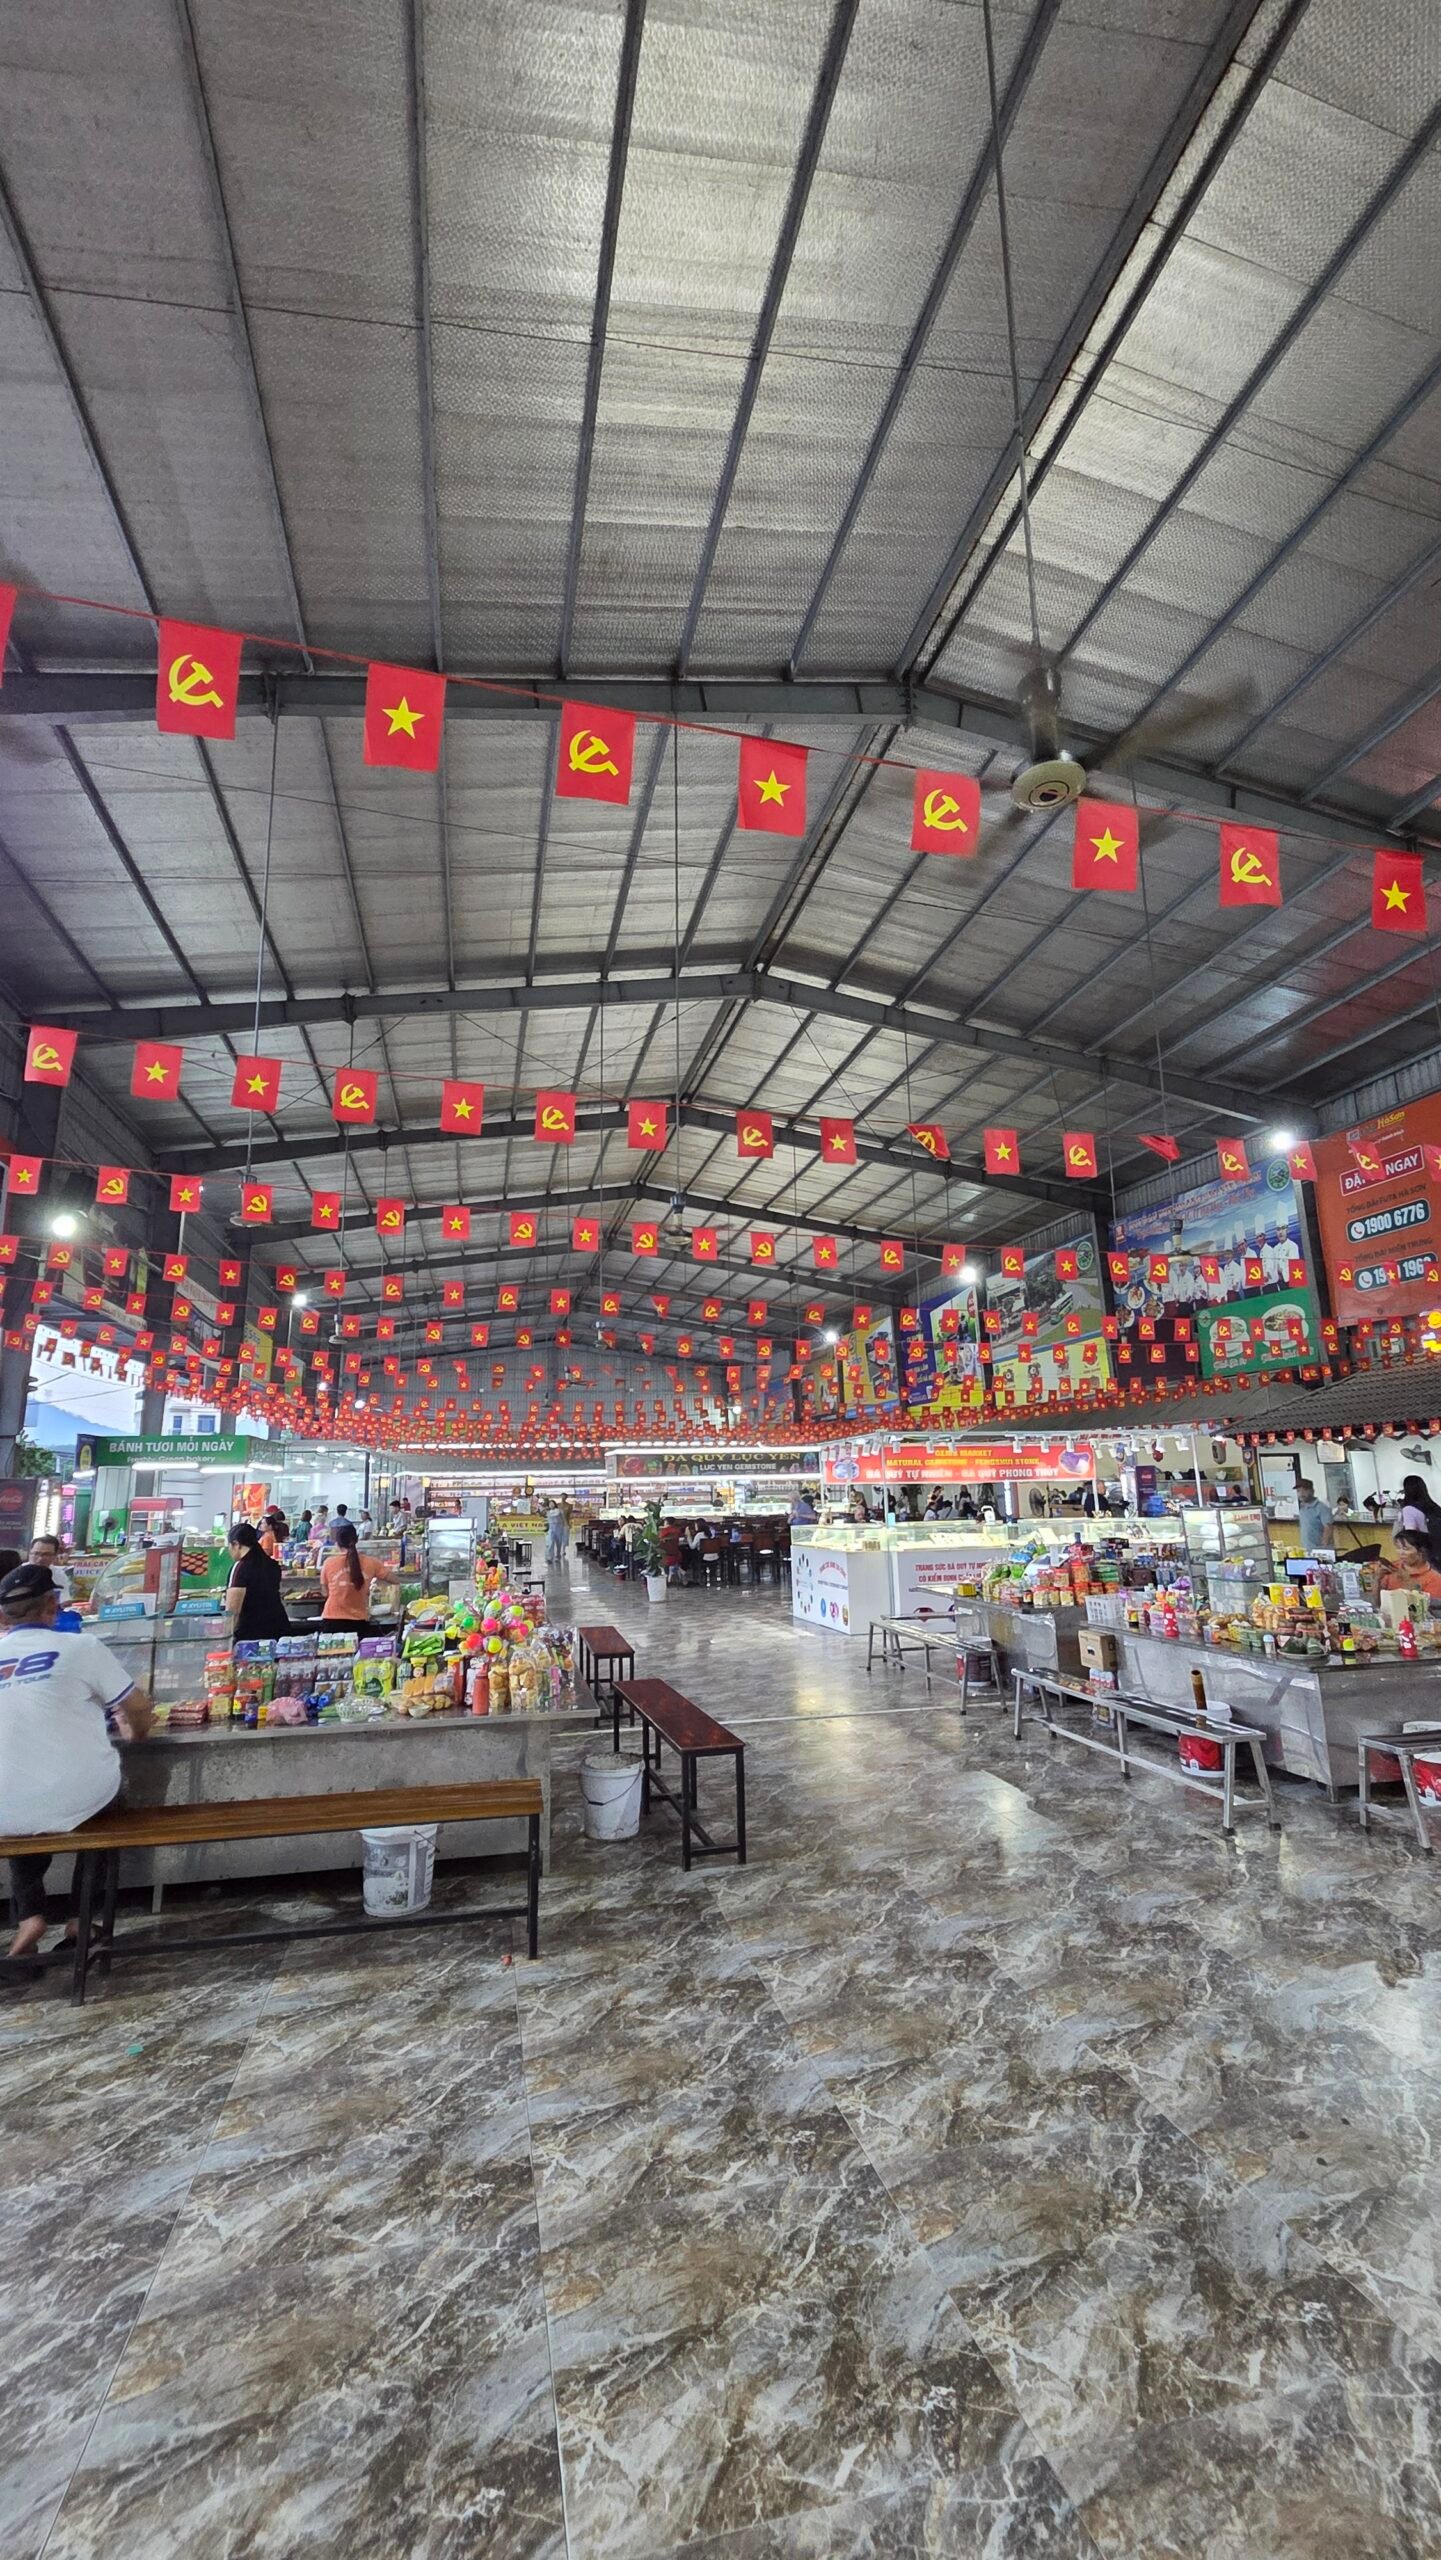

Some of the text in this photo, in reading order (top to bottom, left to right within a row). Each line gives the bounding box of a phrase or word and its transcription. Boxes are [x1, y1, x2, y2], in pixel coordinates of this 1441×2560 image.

[1345, 1154, 1418, 1189] ĐẶ NGAY
[1365, 1203, 1425, 1234] 1900 6776
[109, 1440, 143, 1453] BÁNH
[145, 1441, 173, 1452] TƯƠI
[201, 1439, 234, 1452] NGÀY
[960, 1449, 992, 1457] MARKET
[999, 1468, 1032, 1477] PHONG
